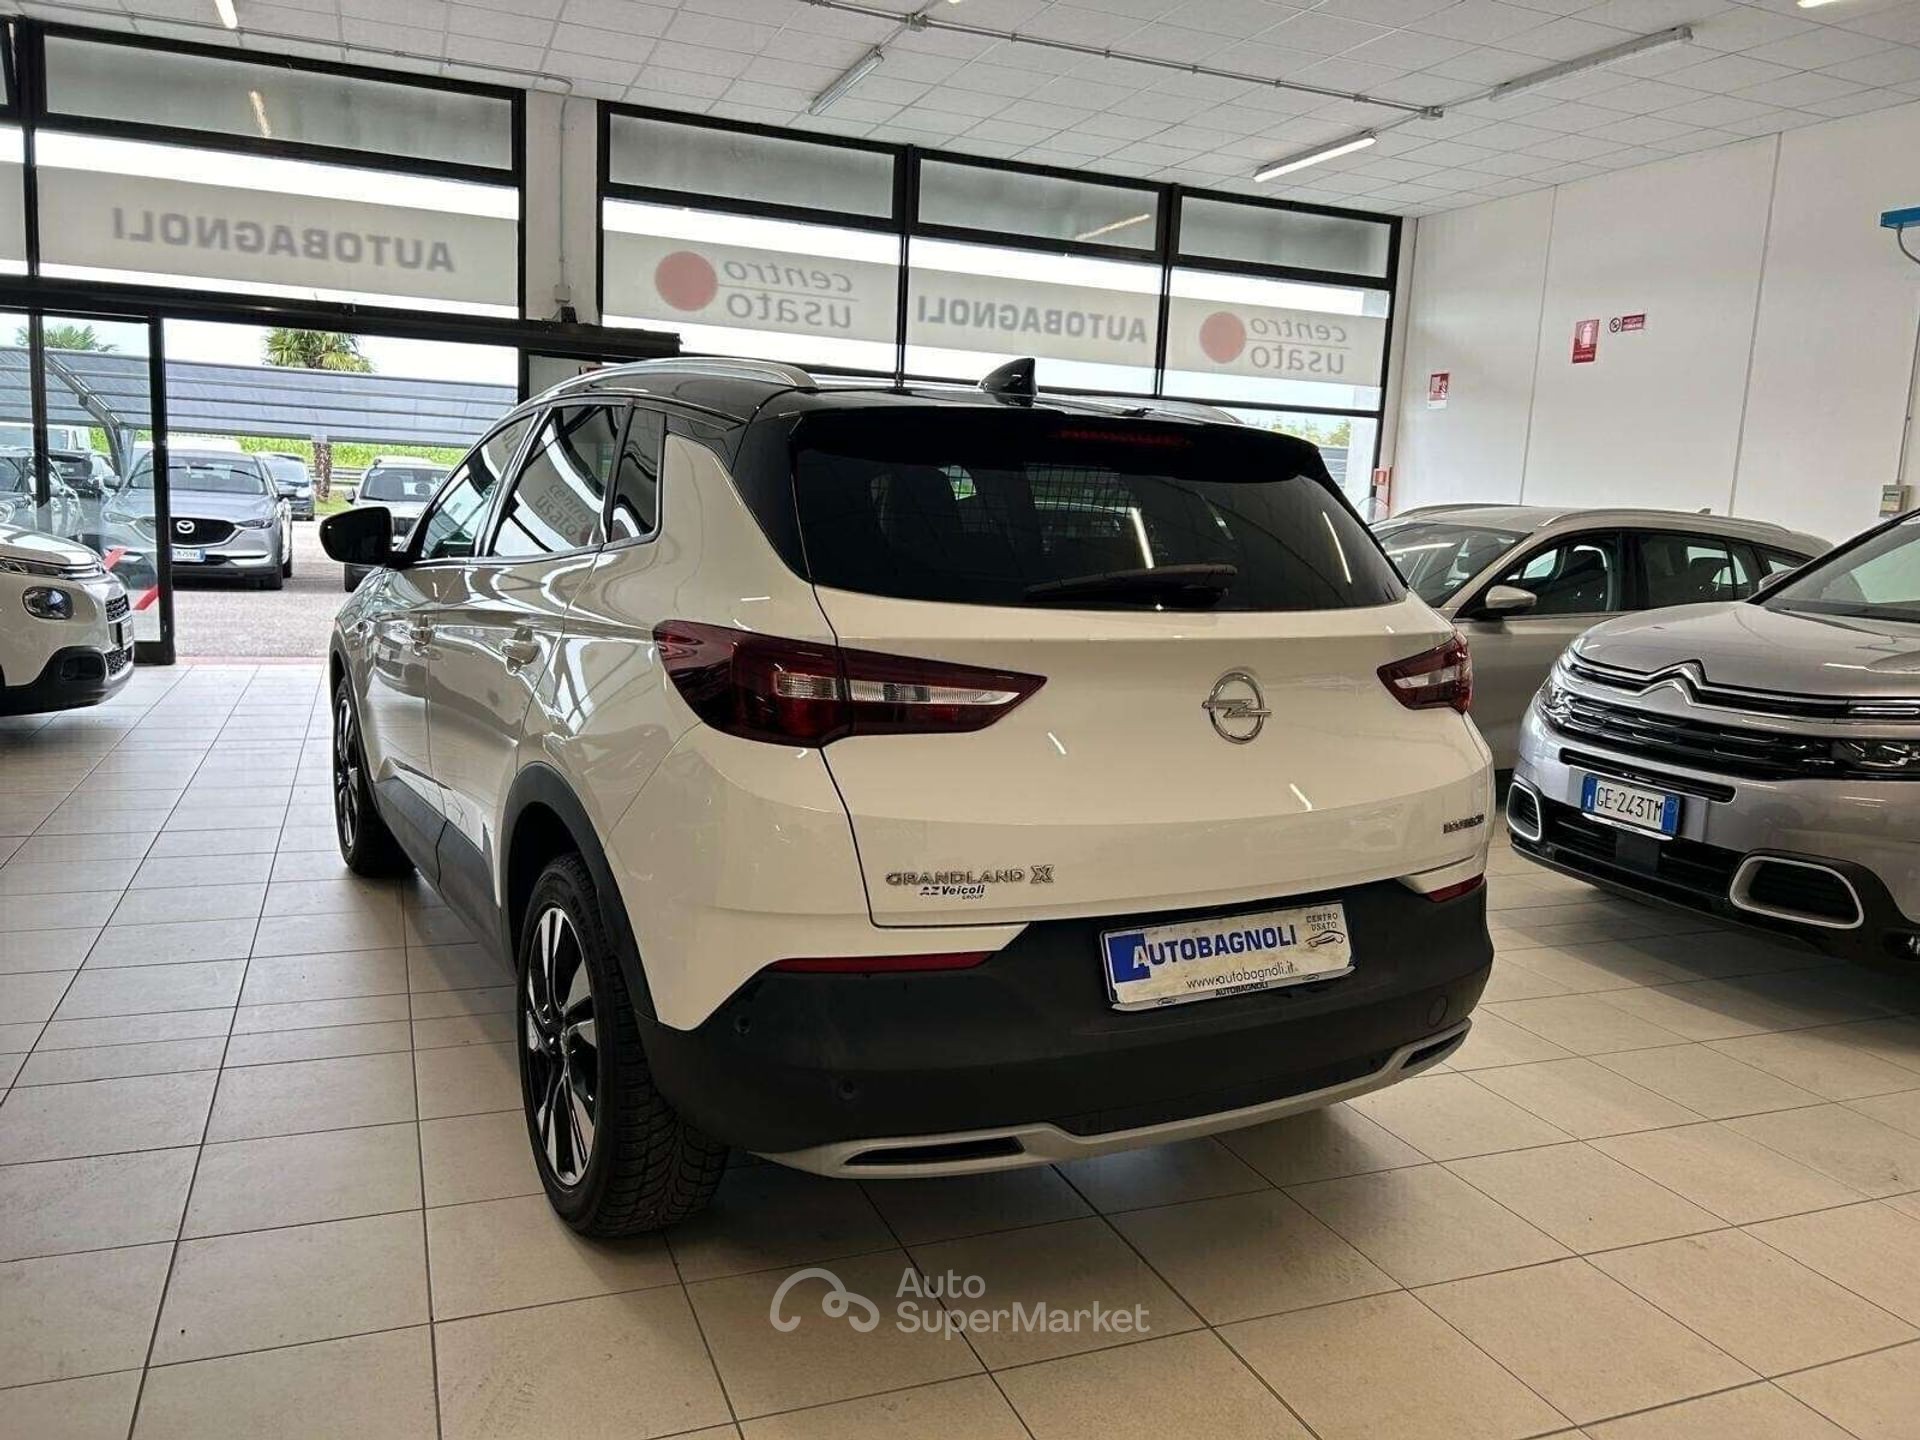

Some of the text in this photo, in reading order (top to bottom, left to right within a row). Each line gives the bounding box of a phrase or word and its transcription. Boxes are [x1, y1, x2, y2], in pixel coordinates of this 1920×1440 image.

[886, 864, 1055, 886] GRANDLAND X
[1306, 912, 1338, 923] CENTRO
[1311, 921, 1337, 932] USATO
[1133, 924, 1298, 970] AUTOBAGNOLI
[1186, 960, 1295, 989] www.autobagnoli.it
[1215, 981, 1269, 997] AUTOBAGNOLI
